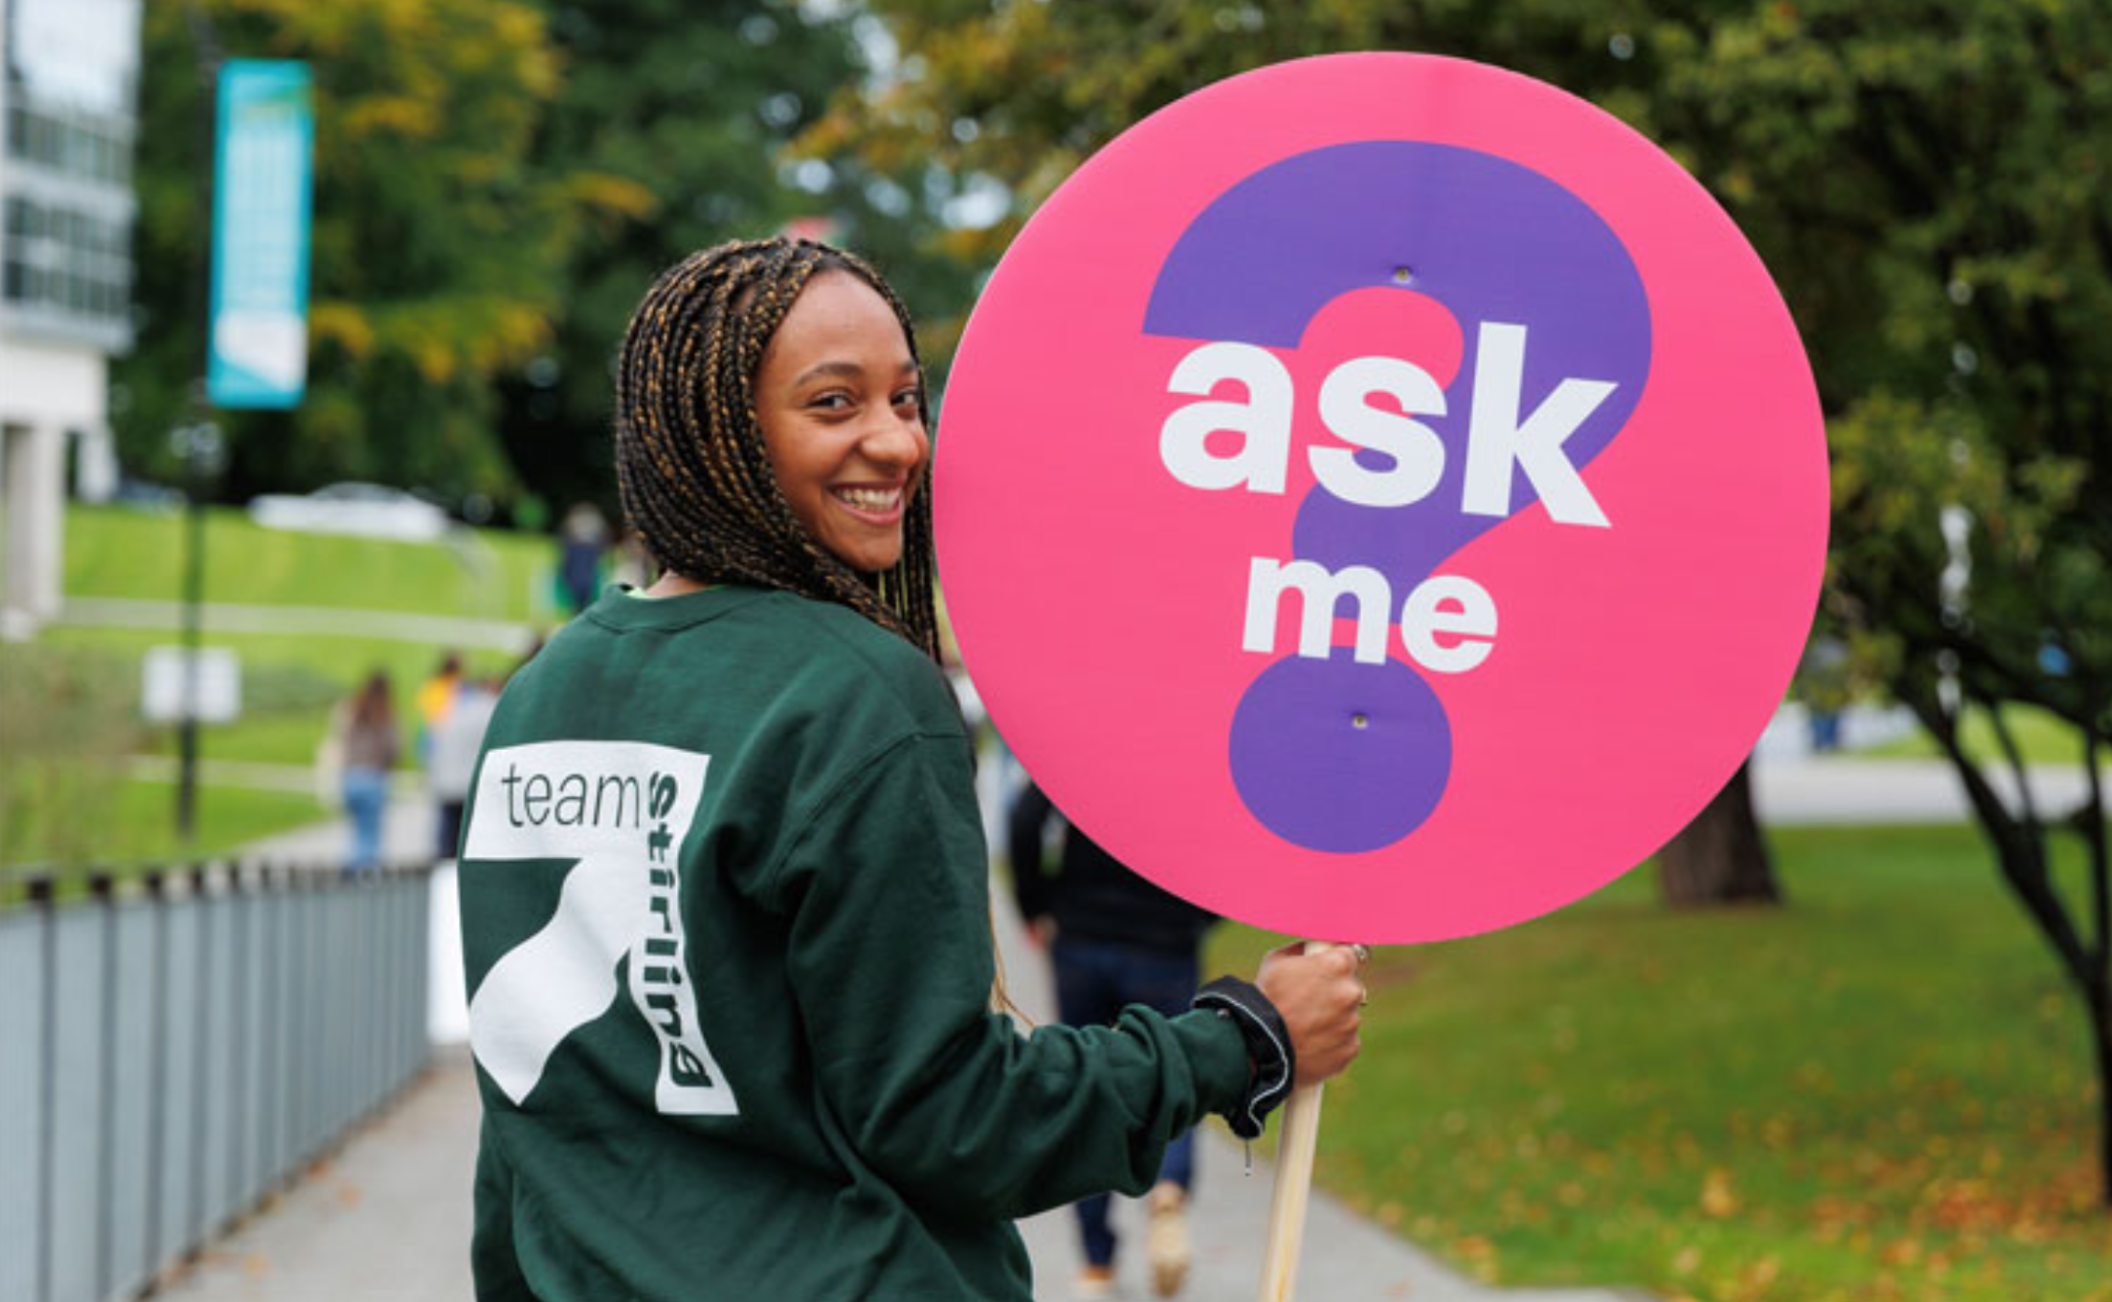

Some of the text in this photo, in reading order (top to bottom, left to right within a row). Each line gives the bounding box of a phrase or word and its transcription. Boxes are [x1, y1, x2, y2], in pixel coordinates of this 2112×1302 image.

[1158, 321, 1618, 528] ask
[1242, 556, 1498, 673] me
[501, 763, 641, 829] team
[643, 770, 715, 1088] stirling
